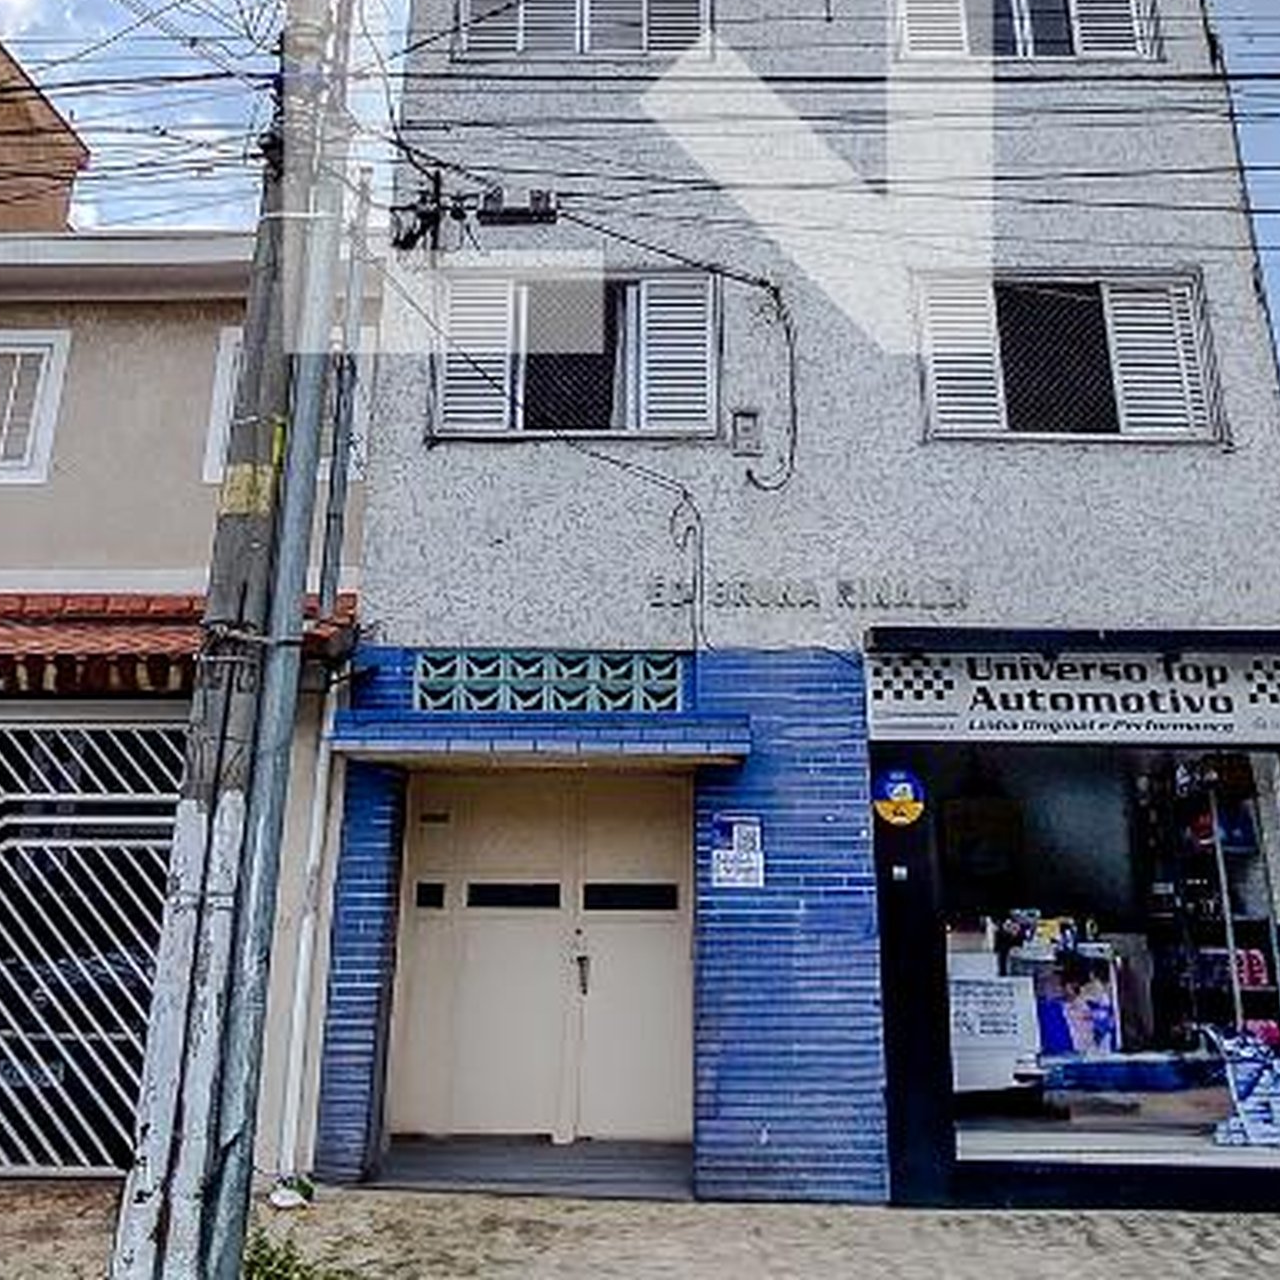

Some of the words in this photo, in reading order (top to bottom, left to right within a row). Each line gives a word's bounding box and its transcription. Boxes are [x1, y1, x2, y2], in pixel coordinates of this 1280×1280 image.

[965, 656, 1148, 682] Universo
[1155, 656, 1229, 689] Top
[970, 686, 1234, 714] Automotivo
[1112, 718, 1235, 734] Performance
